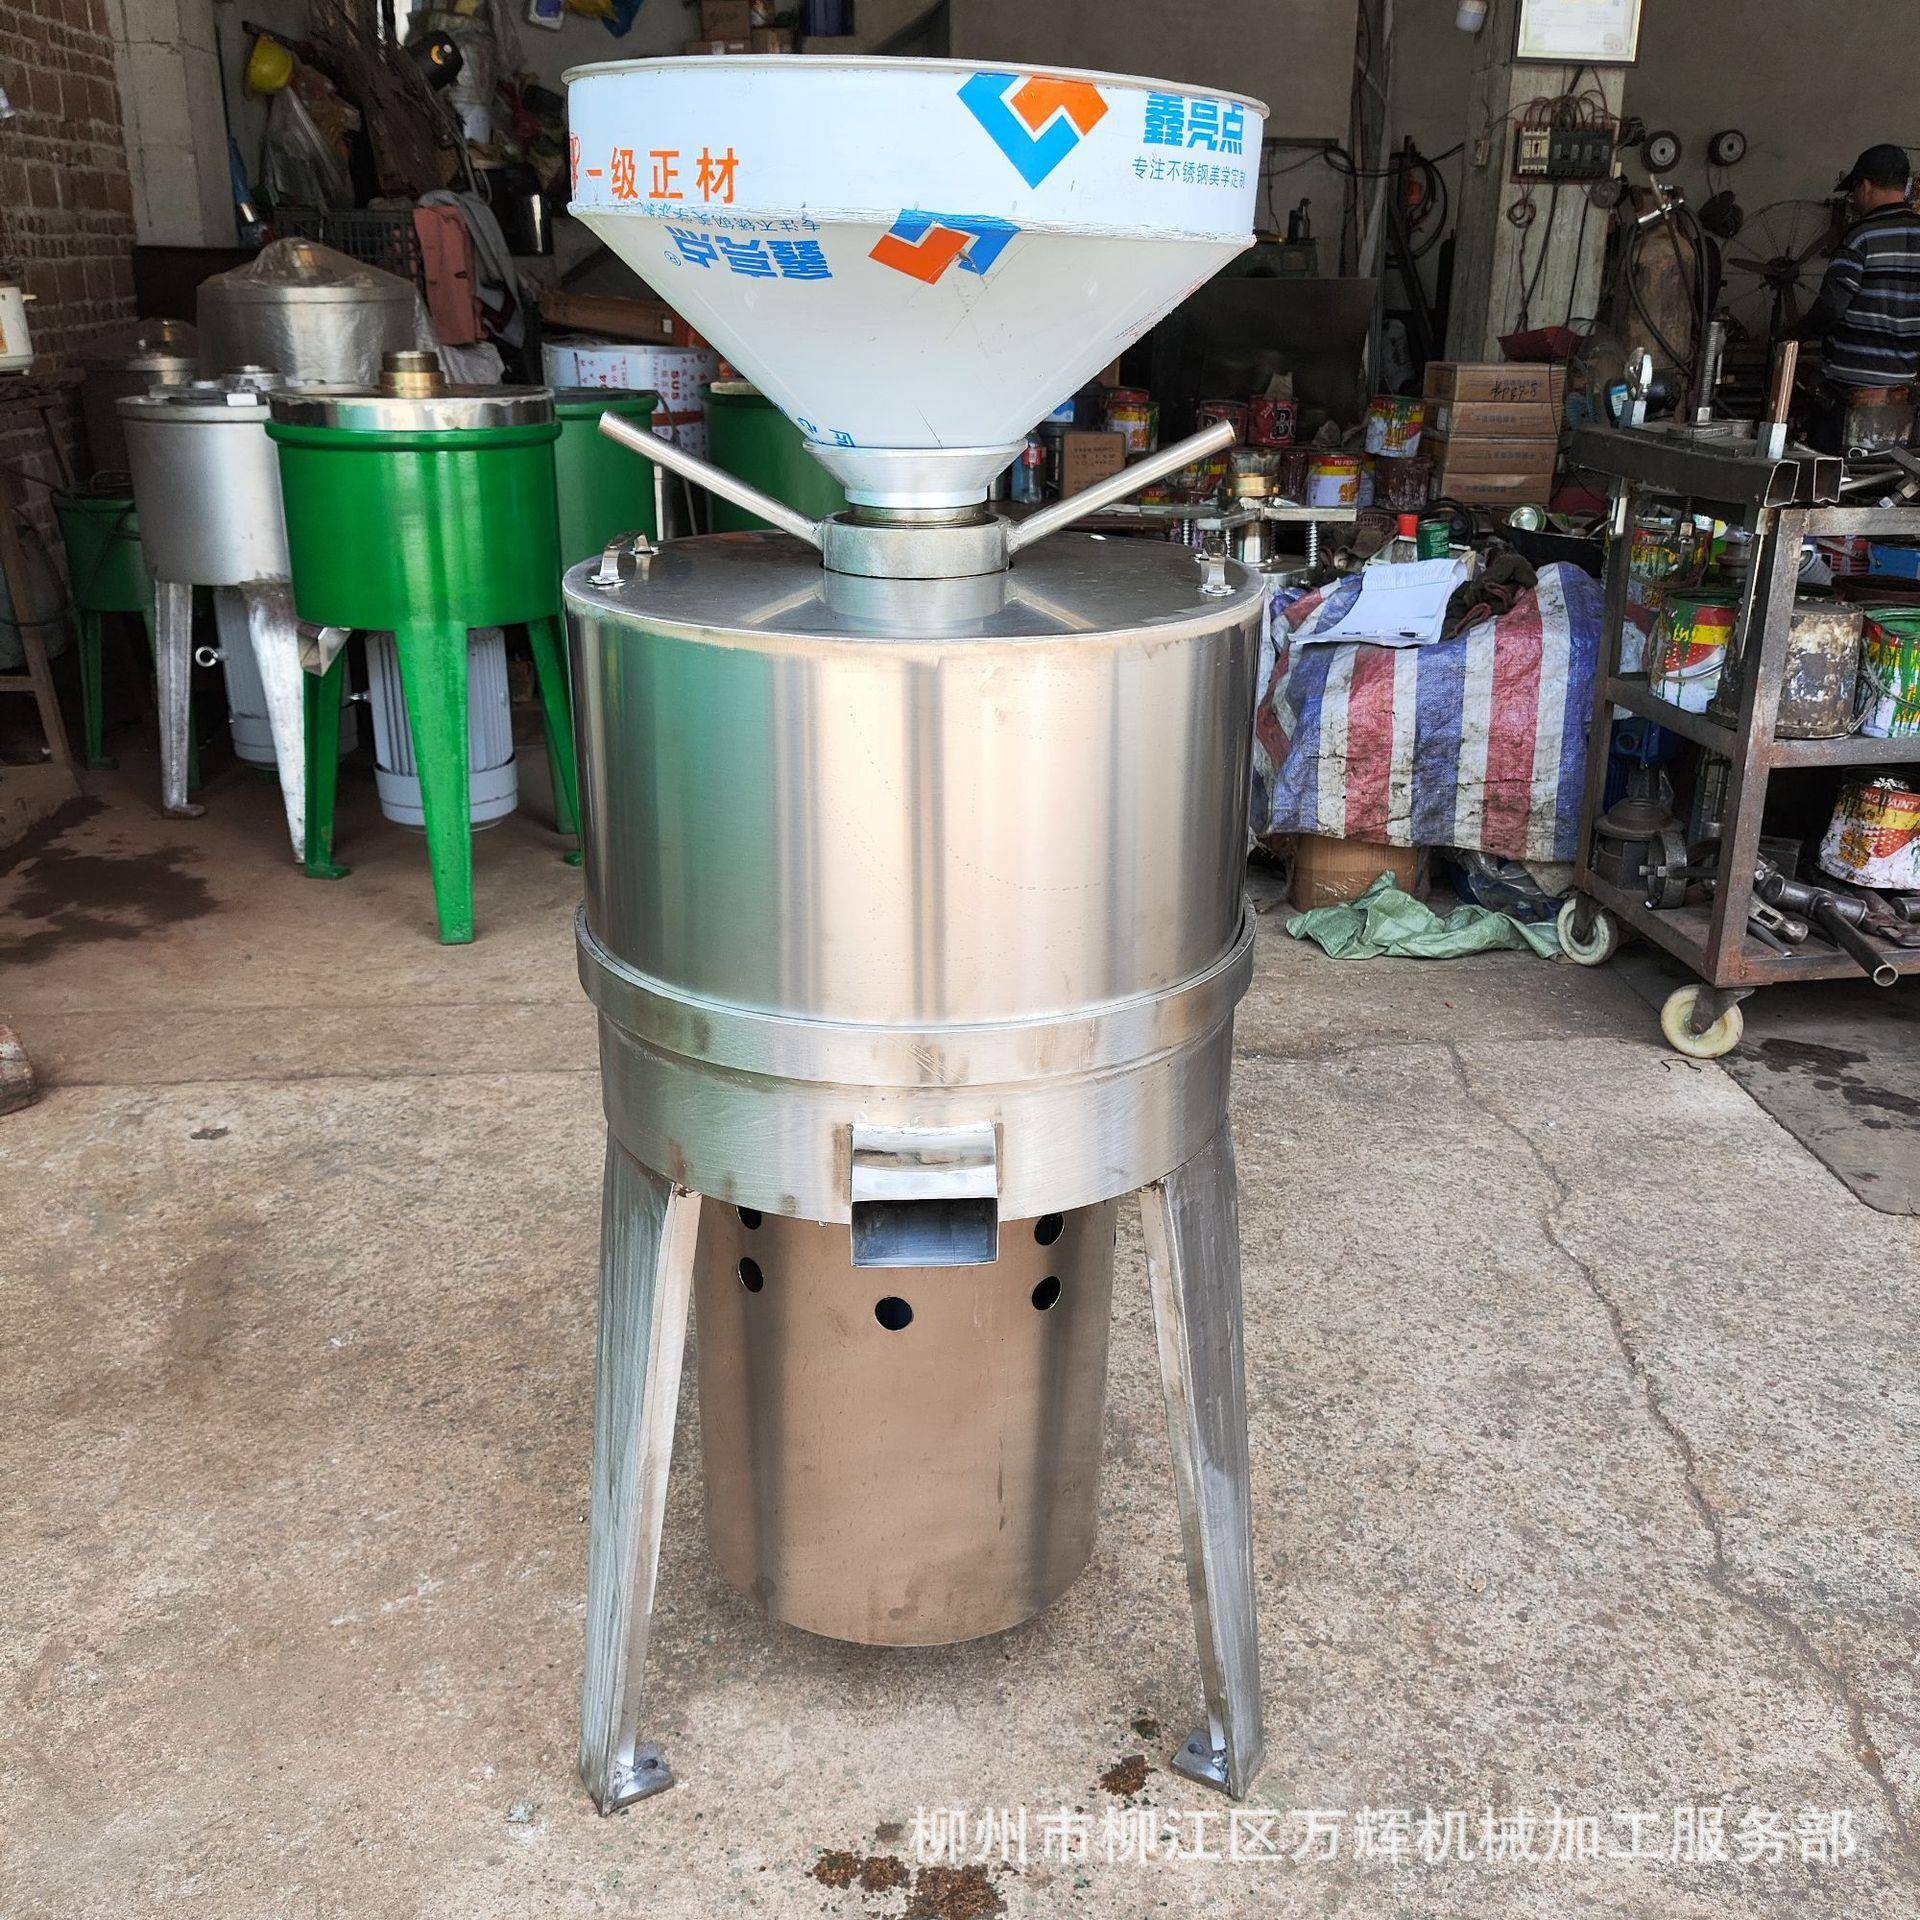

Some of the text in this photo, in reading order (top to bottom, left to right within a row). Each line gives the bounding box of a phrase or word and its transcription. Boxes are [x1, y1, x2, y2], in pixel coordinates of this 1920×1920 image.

[1143, 90, 1244, 155] 鑫亮点
[1131, 154, 1247, 189] 专注不锈钢美学定制
